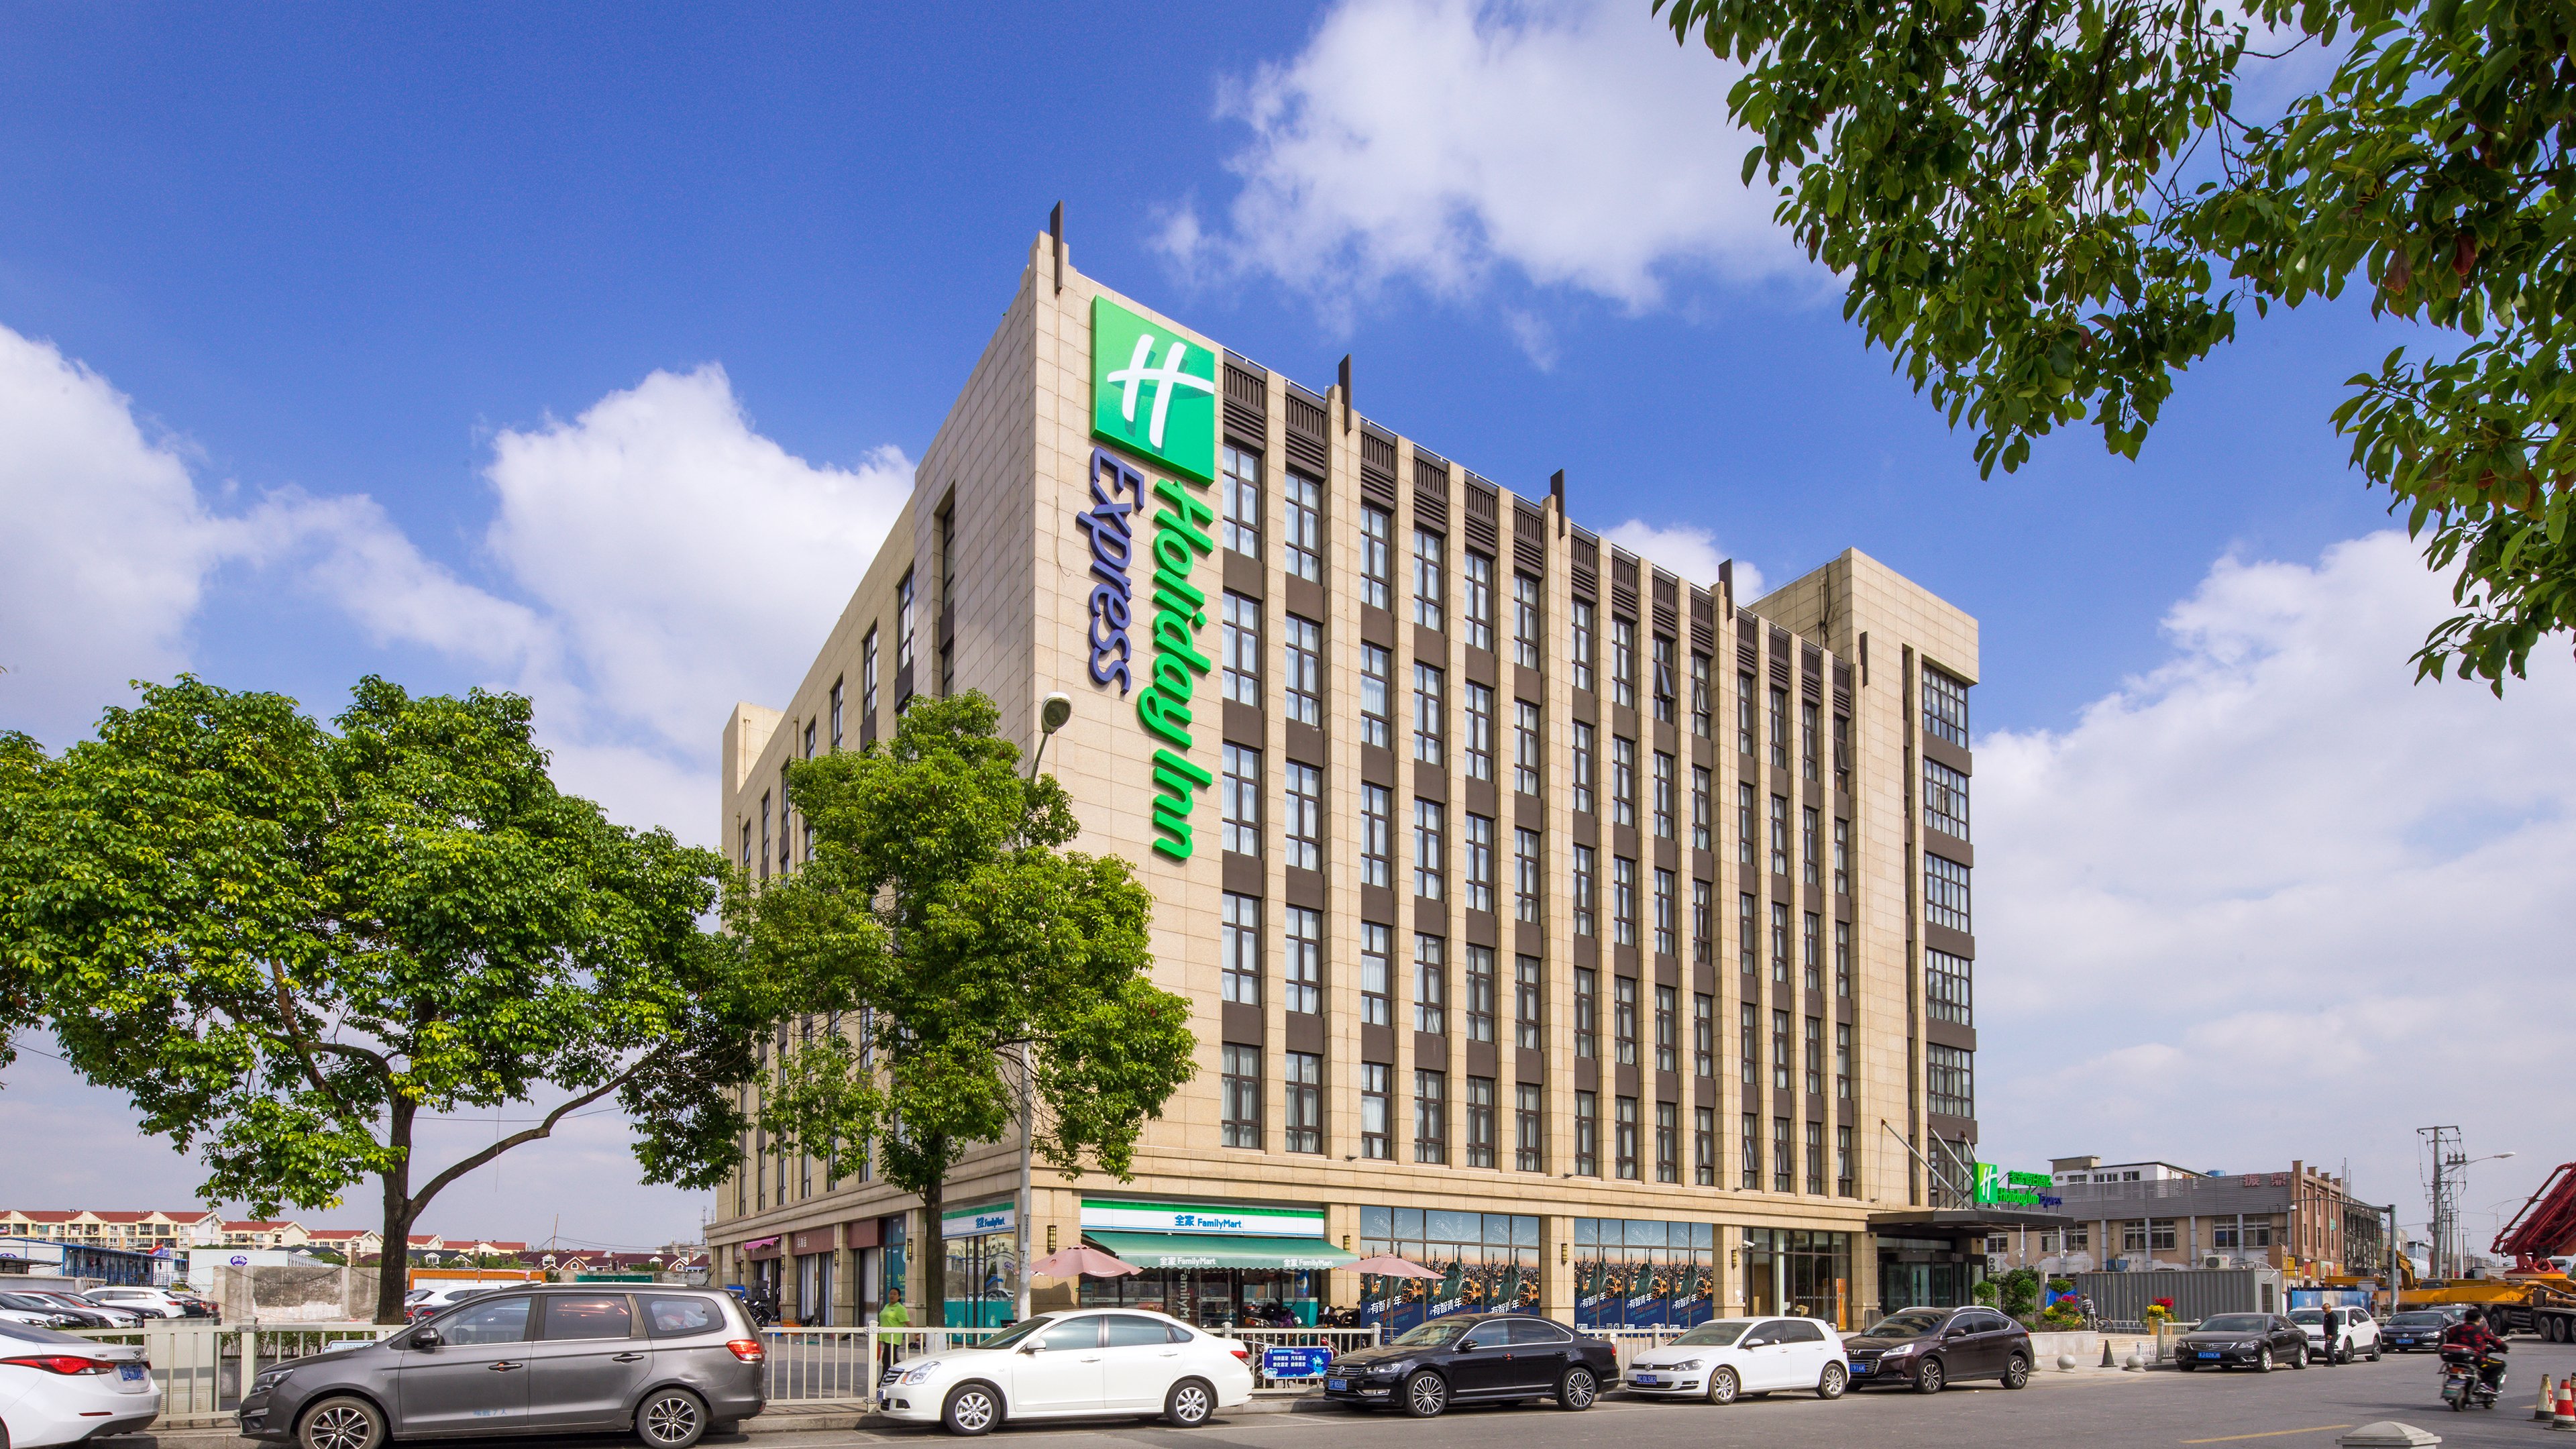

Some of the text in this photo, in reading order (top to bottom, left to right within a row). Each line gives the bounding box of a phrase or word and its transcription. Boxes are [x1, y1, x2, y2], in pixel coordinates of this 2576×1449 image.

[1076, 445, 1144, 696] Express
[1137, 478, 1214, 861] Holiday Inn
[1997, 1187, 2028, 1207] Holiday
[2025, 1189, 2040, 1204] Inn
[1175, 1215, 1242, 1230] 全家 FamilyMart
[1159, 1256, 1216, 1267] 全家 FamilyMart
[1283, 1258, 1334, 1268] 全家 FamilyMart
